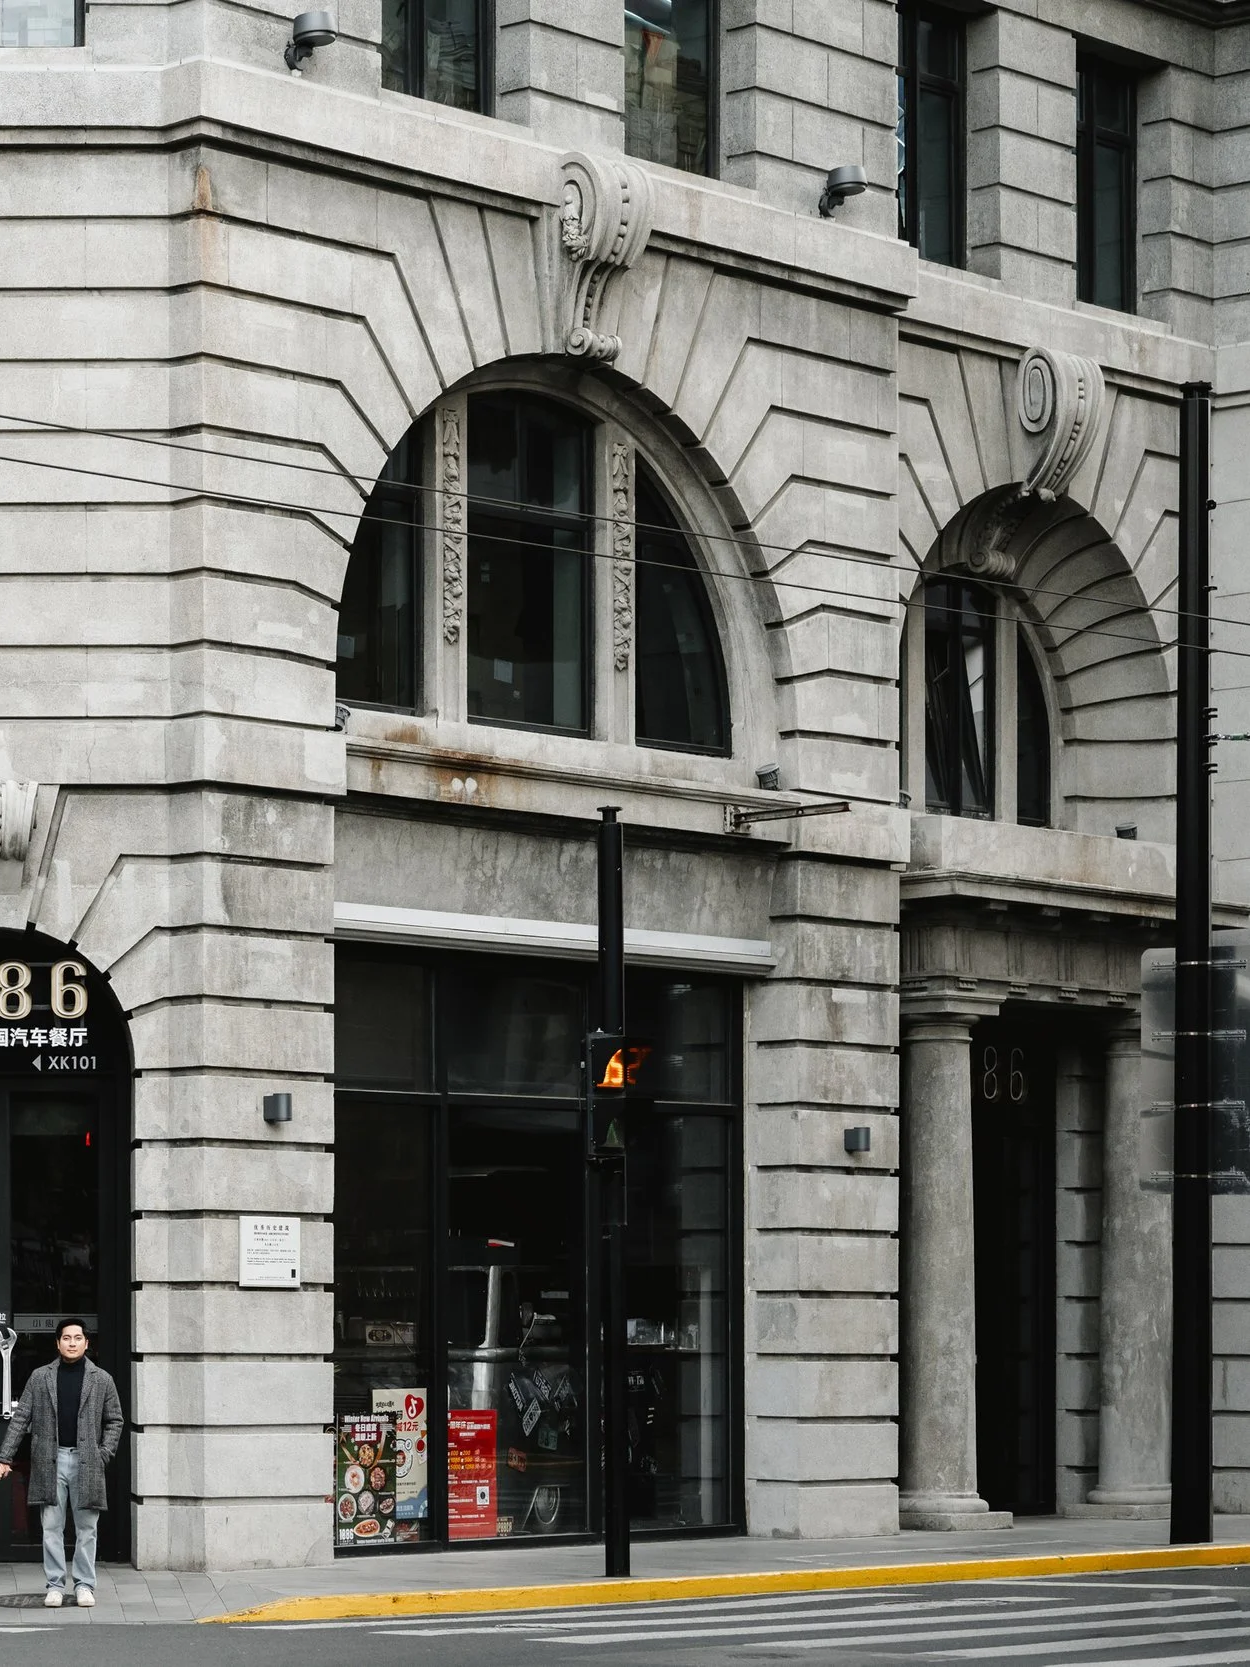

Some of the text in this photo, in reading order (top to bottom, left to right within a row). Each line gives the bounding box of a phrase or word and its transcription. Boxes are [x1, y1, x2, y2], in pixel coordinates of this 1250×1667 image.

[48, 1055, 97, 1070] XK101
[344, 1415, 361, 1423] Winter
[371, 1414, 389, 1423] Arrivals
[339, 1528, 354, 1540] 1886
